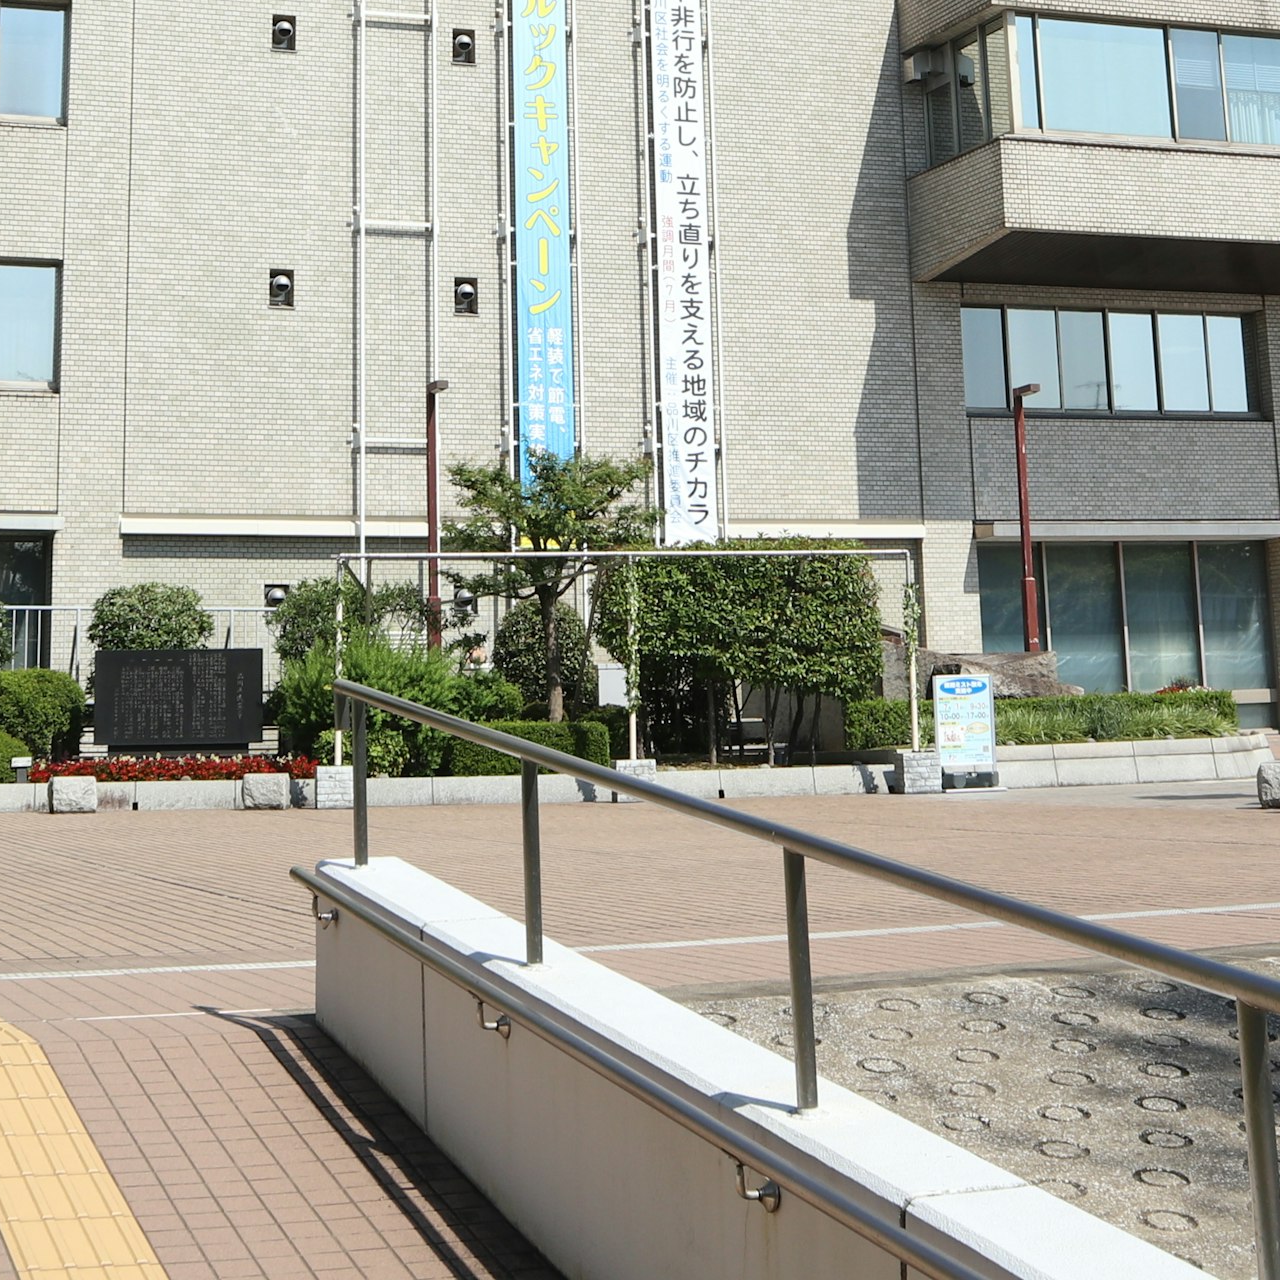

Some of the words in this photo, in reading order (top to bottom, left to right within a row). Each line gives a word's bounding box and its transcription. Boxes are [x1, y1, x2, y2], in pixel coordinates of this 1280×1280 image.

[546, 327, 566, 433] 軽装で節電、
